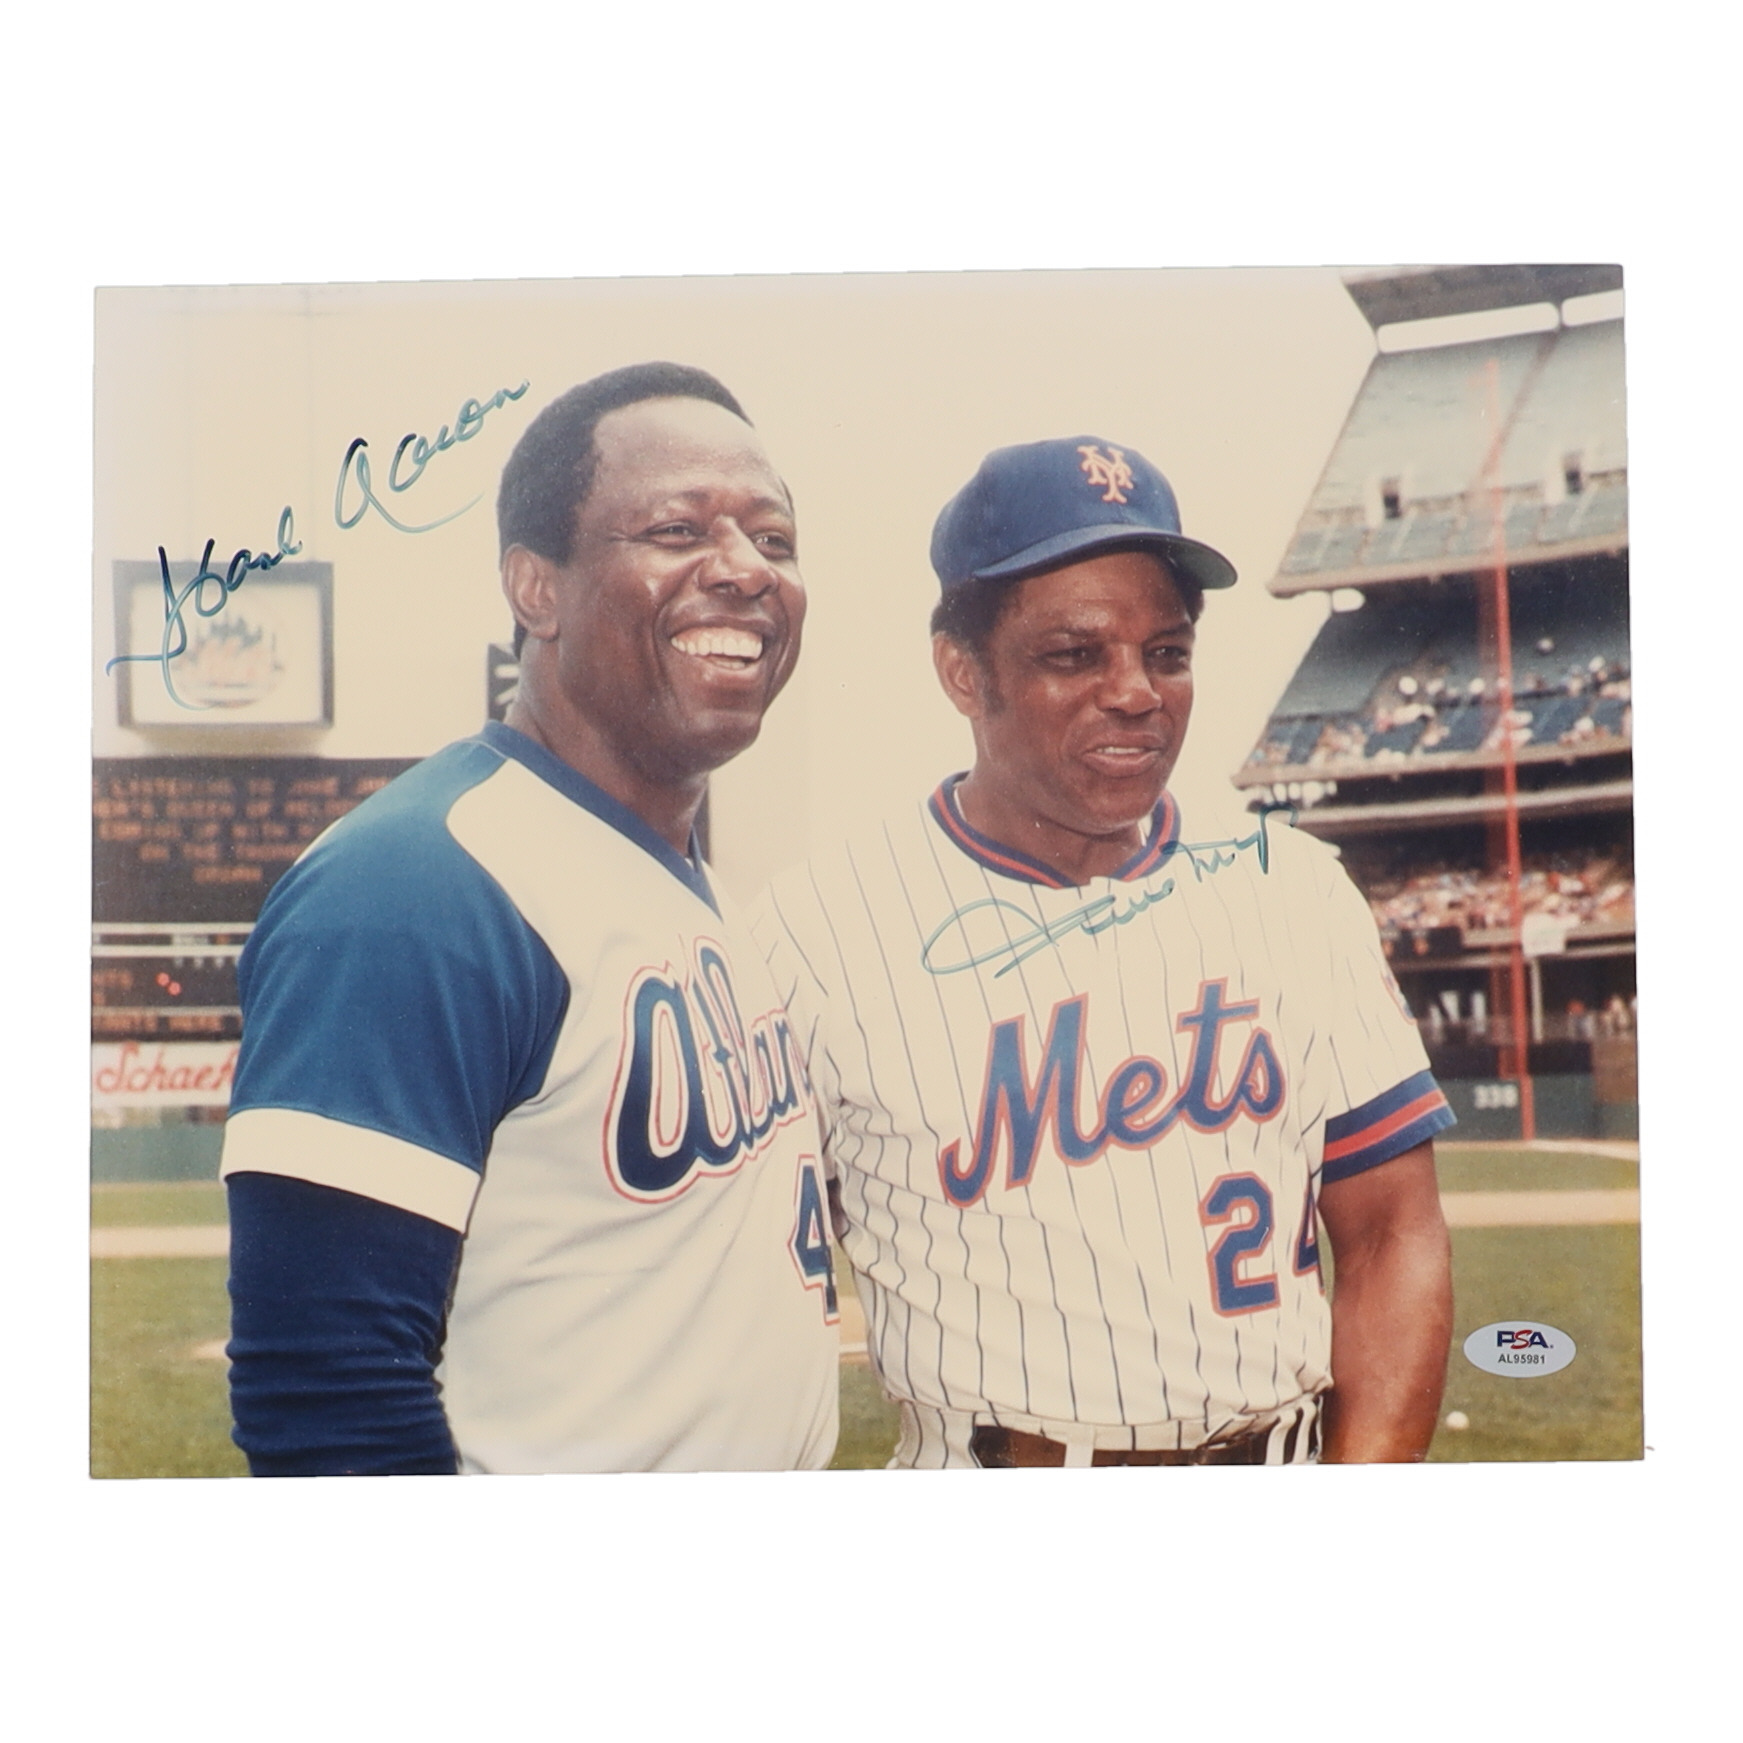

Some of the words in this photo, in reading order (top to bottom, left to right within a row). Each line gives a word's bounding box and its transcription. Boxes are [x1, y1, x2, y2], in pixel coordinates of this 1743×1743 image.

[939, 977, 1287, 1208] Mets
[1197, 1170, 1325, 1319] 24
[1496, 1329, 1550, 1350] PSA
[1497, 1353, 1546, 1365] AL95981
